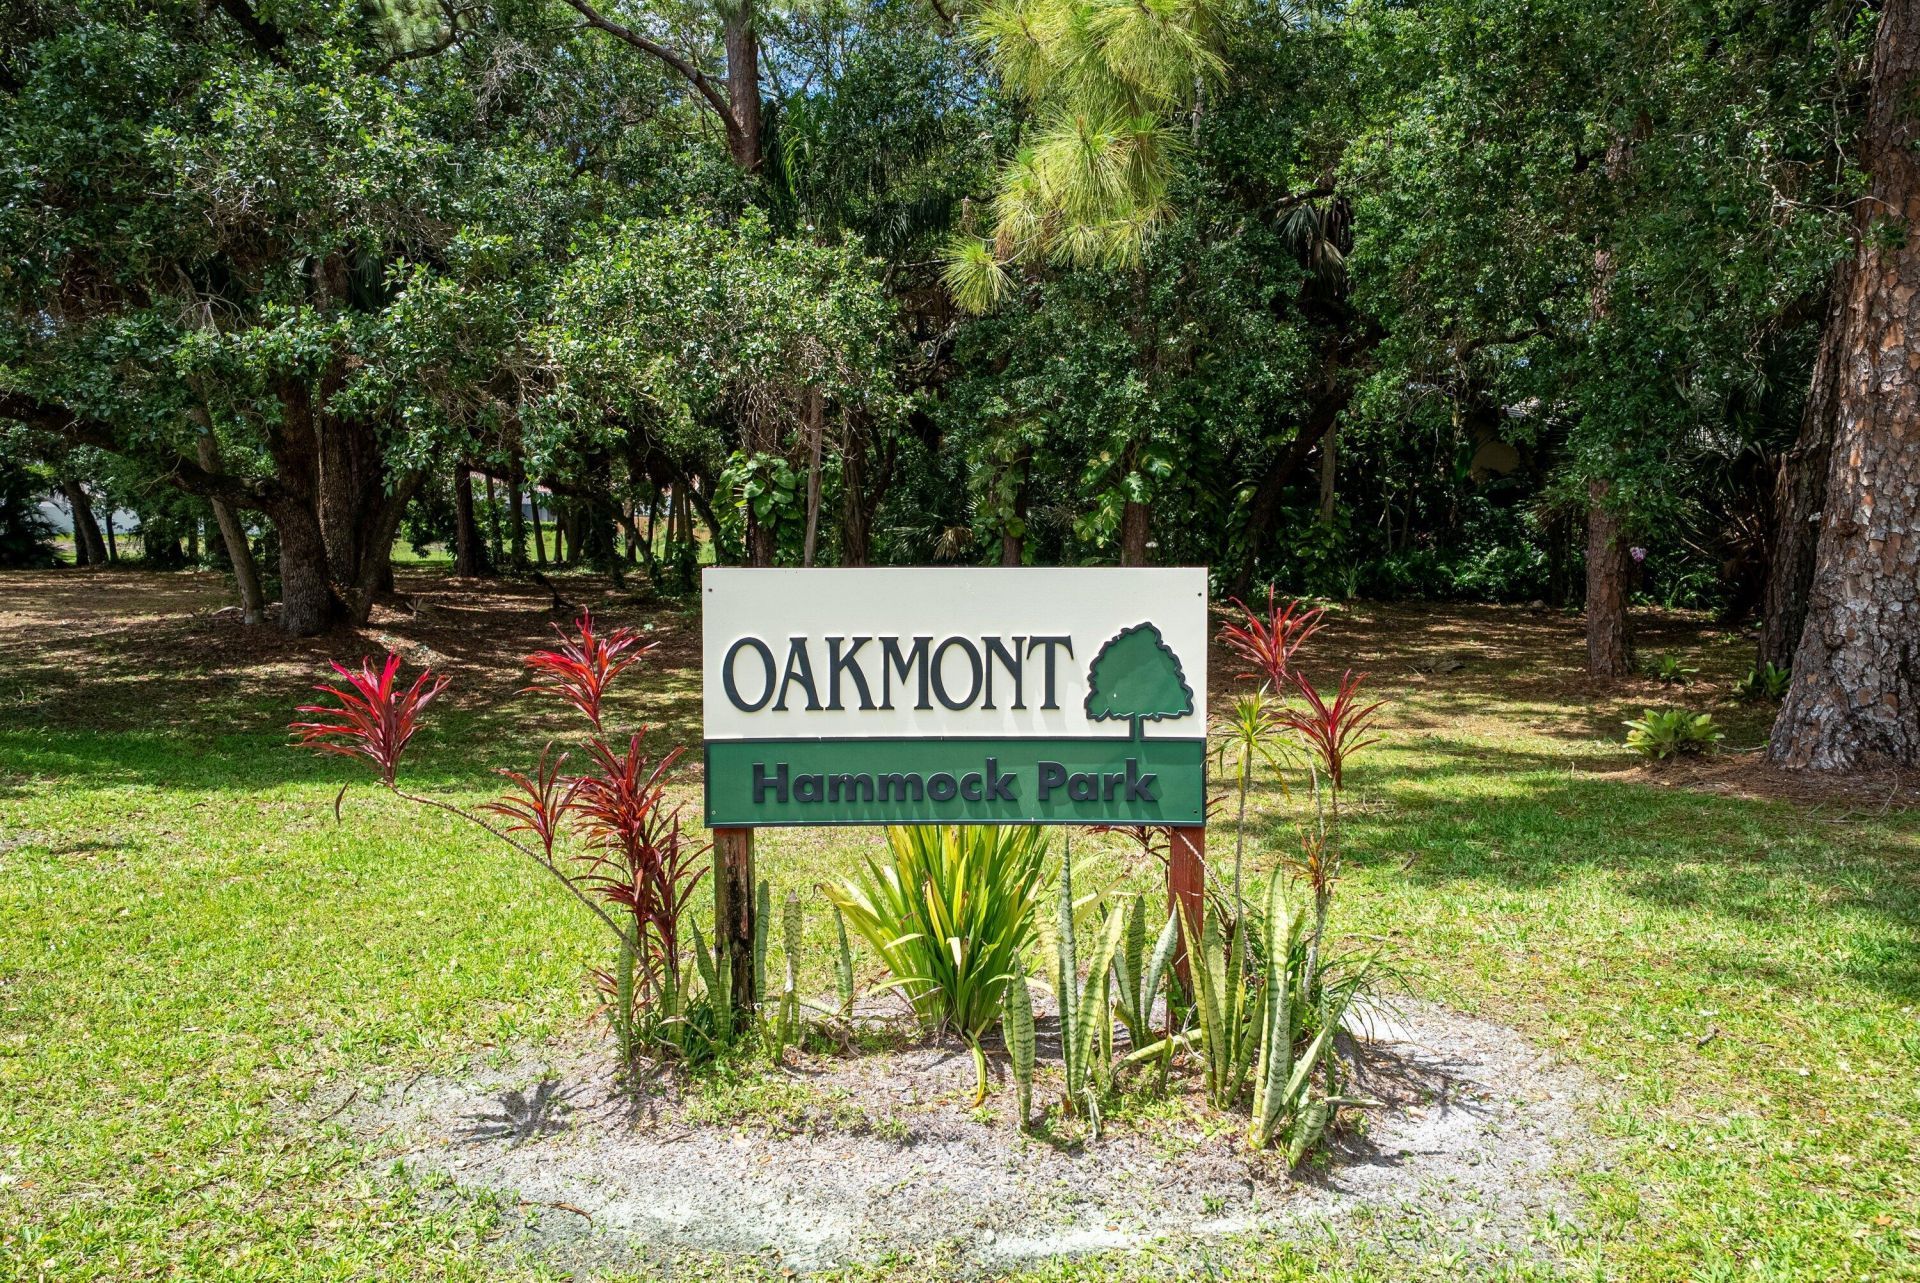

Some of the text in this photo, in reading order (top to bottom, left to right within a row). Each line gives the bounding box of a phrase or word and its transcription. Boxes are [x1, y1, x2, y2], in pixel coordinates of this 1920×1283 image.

[722, 635, 1074, 713] OAKMONT
[752, 757, 1158, 803] Hammock Park
